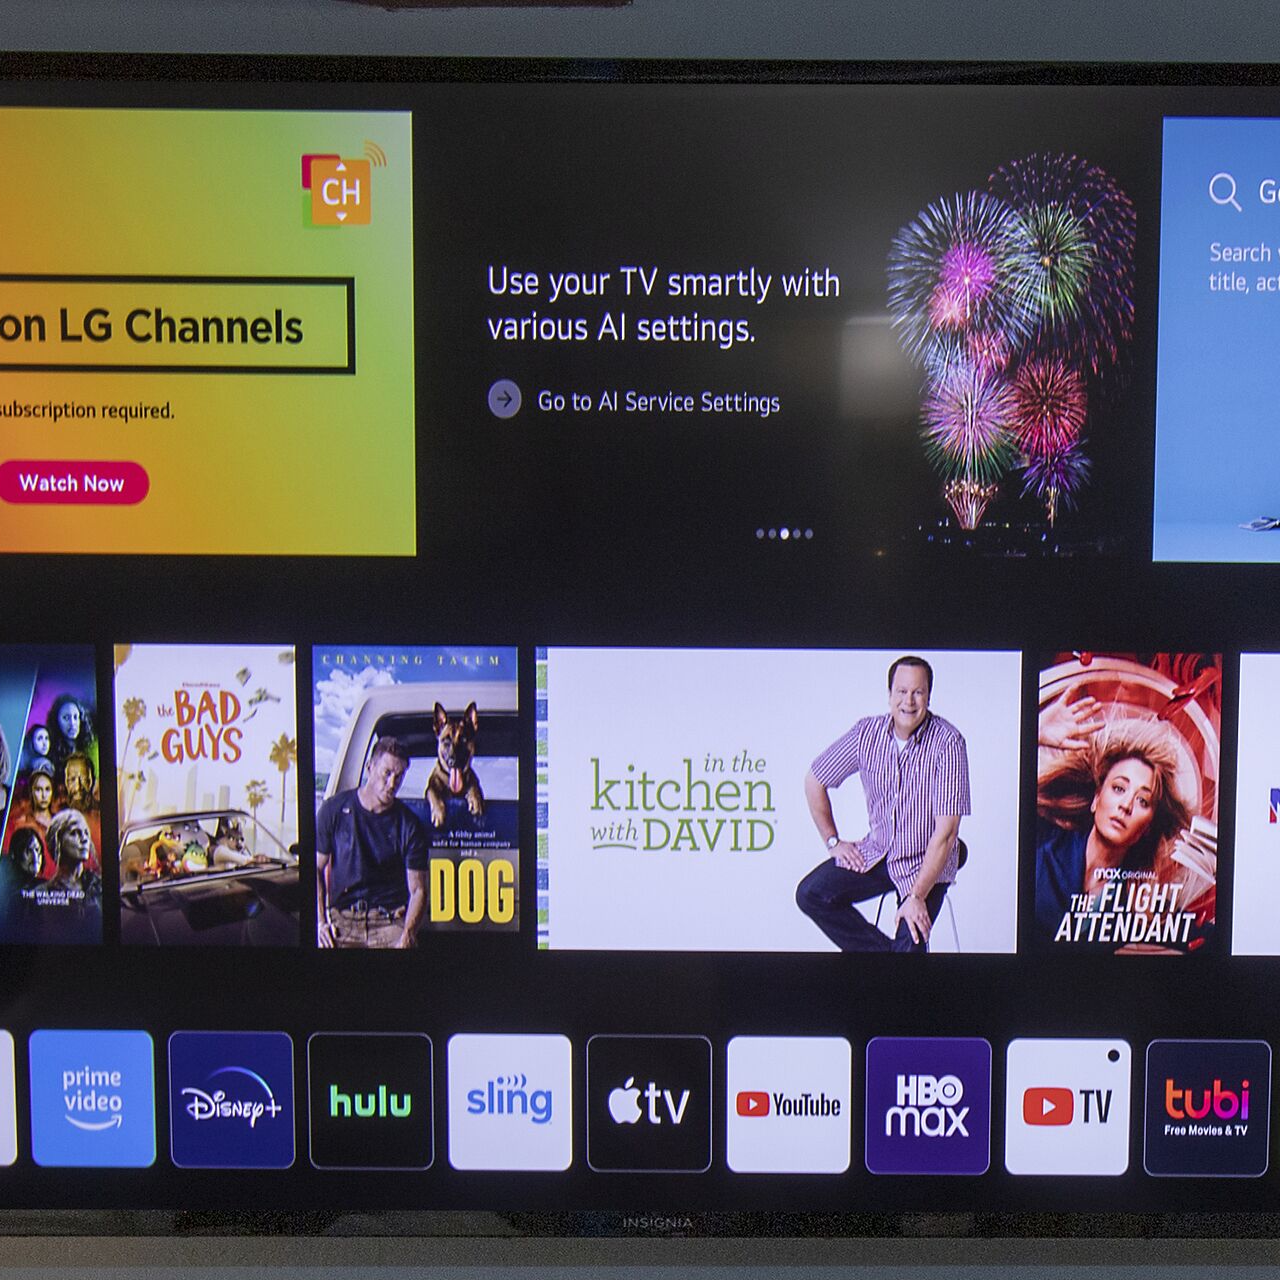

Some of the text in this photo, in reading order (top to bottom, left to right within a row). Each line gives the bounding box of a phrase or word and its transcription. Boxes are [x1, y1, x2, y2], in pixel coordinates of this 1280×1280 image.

[322, 178, 361, 205] CH
[1209, 242, 1271, 263] Search
[487, 265, 841, 304] Use your TV smartly with
[1209, 272, 1250, 294] title,
[60, 308, 113, 343] LG
[125, 309, 304, 345] Channels
[487, 311, 756, 349] various AI settings.
[101, 403, 176, 424] required.
[538, 389, 781, 418] Go to AI Service Settings
[18, 473, 126, 493] Watch Now
[322, 654, 500, 667] CHANNING TATUM
[156, 688, 242, 728] the BAD
[161, 723, 244, 765] GUYS
[704, 749, 767, 774] in the
[590, 758, 776, 812] kitchen
[590, 818, 776, 852] with DAVID
[430, 858, 515, 924] DOG
[1070, 882, 1184, 913] THE FLIGHT
[1054, 912, 1197, 943] ATTENDANT
[63, 1066, 122, 1091] prime
[896, 1074, 964, 1106] HBO
[64, 1091, 123, 1112] video
[330, 1084, 412, 1118] hulu
[467, 1076, 553, 1125] sling
[645, 1081, 690, 1125] tv
[773, 1092, 841, 1117] YouTube
[1079, 1089, 1113, 1124] TV
[1165, 1078, 1250, 1121] tubi
[885, 1105, 970, 1138] max
[1164, 1124, 1248, 1137] Free Movies & TV
[623, 1217, 694, 1229] INSIGNIA
